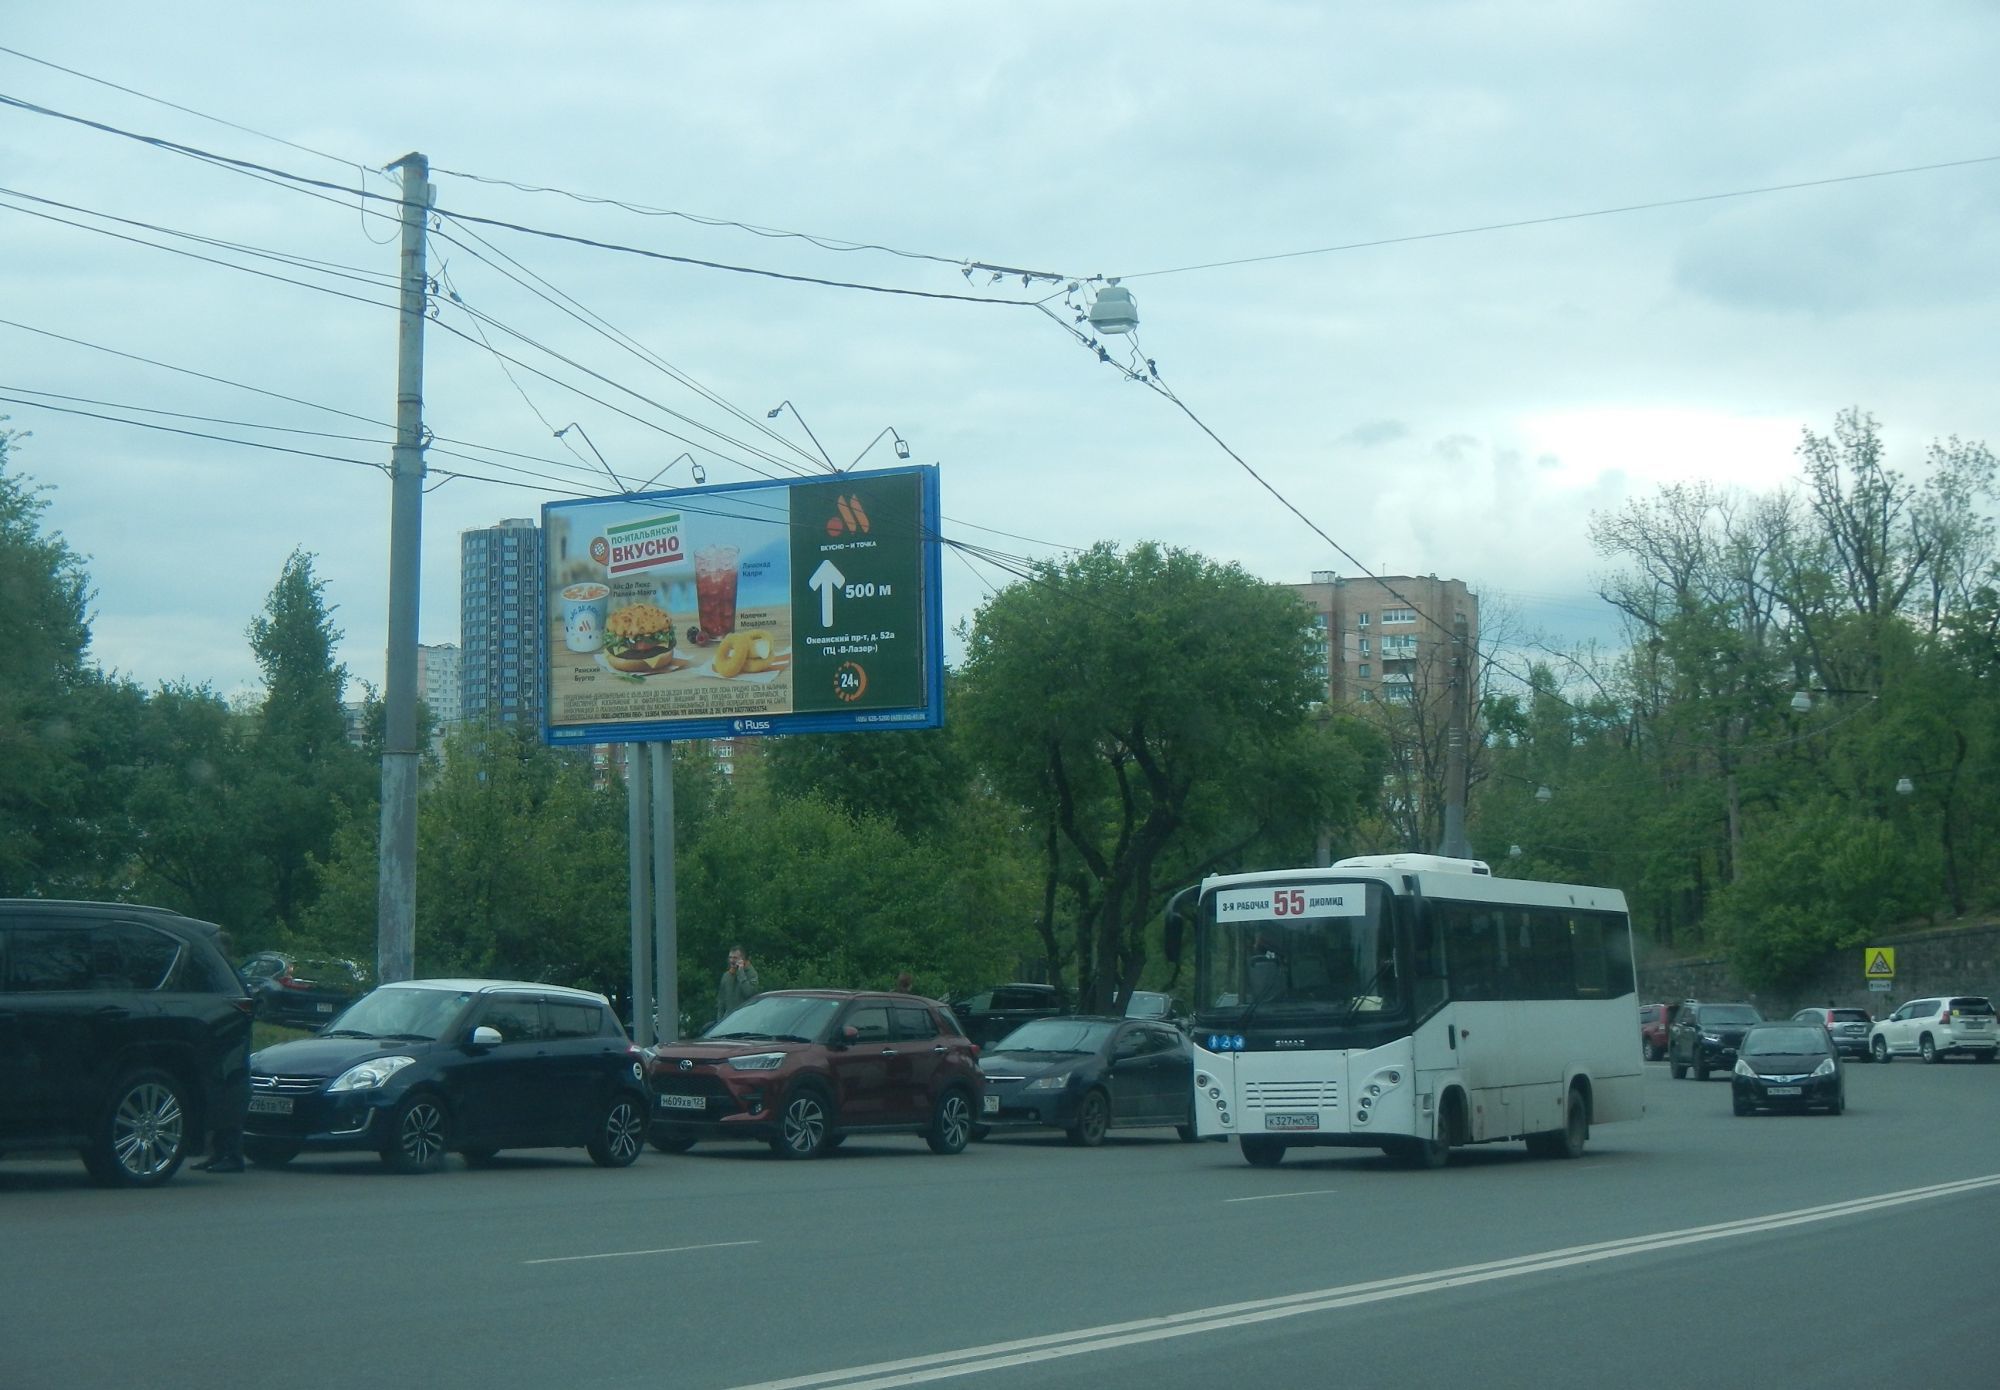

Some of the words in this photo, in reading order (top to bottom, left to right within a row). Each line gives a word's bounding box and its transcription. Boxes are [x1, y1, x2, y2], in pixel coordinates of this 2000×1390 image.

[611, 525, 678, 545] ПО-ИТАЛЬЯНСКИ
[613, 536, 680, 563] ВКУСНО
[820, 544, 844, 552] ВКУСНО
[845, 582, 875, 599] 500
[806, 634, 850, 645] Океанский
[851, 634, 870, 643] пр-т,
[880, 631, 895, 640] 52а
[823, 646, 836, 656] (ТЦ
[745, 720, 770, 730] Russ
[1222, 902, 1235, 912] 3-Я
[1236, 900, 1270, 911] РАБОЧАЯ
[1274, 889, 1305, 916] 55
[1309, 896, 1344, 908] ДИОМИД
